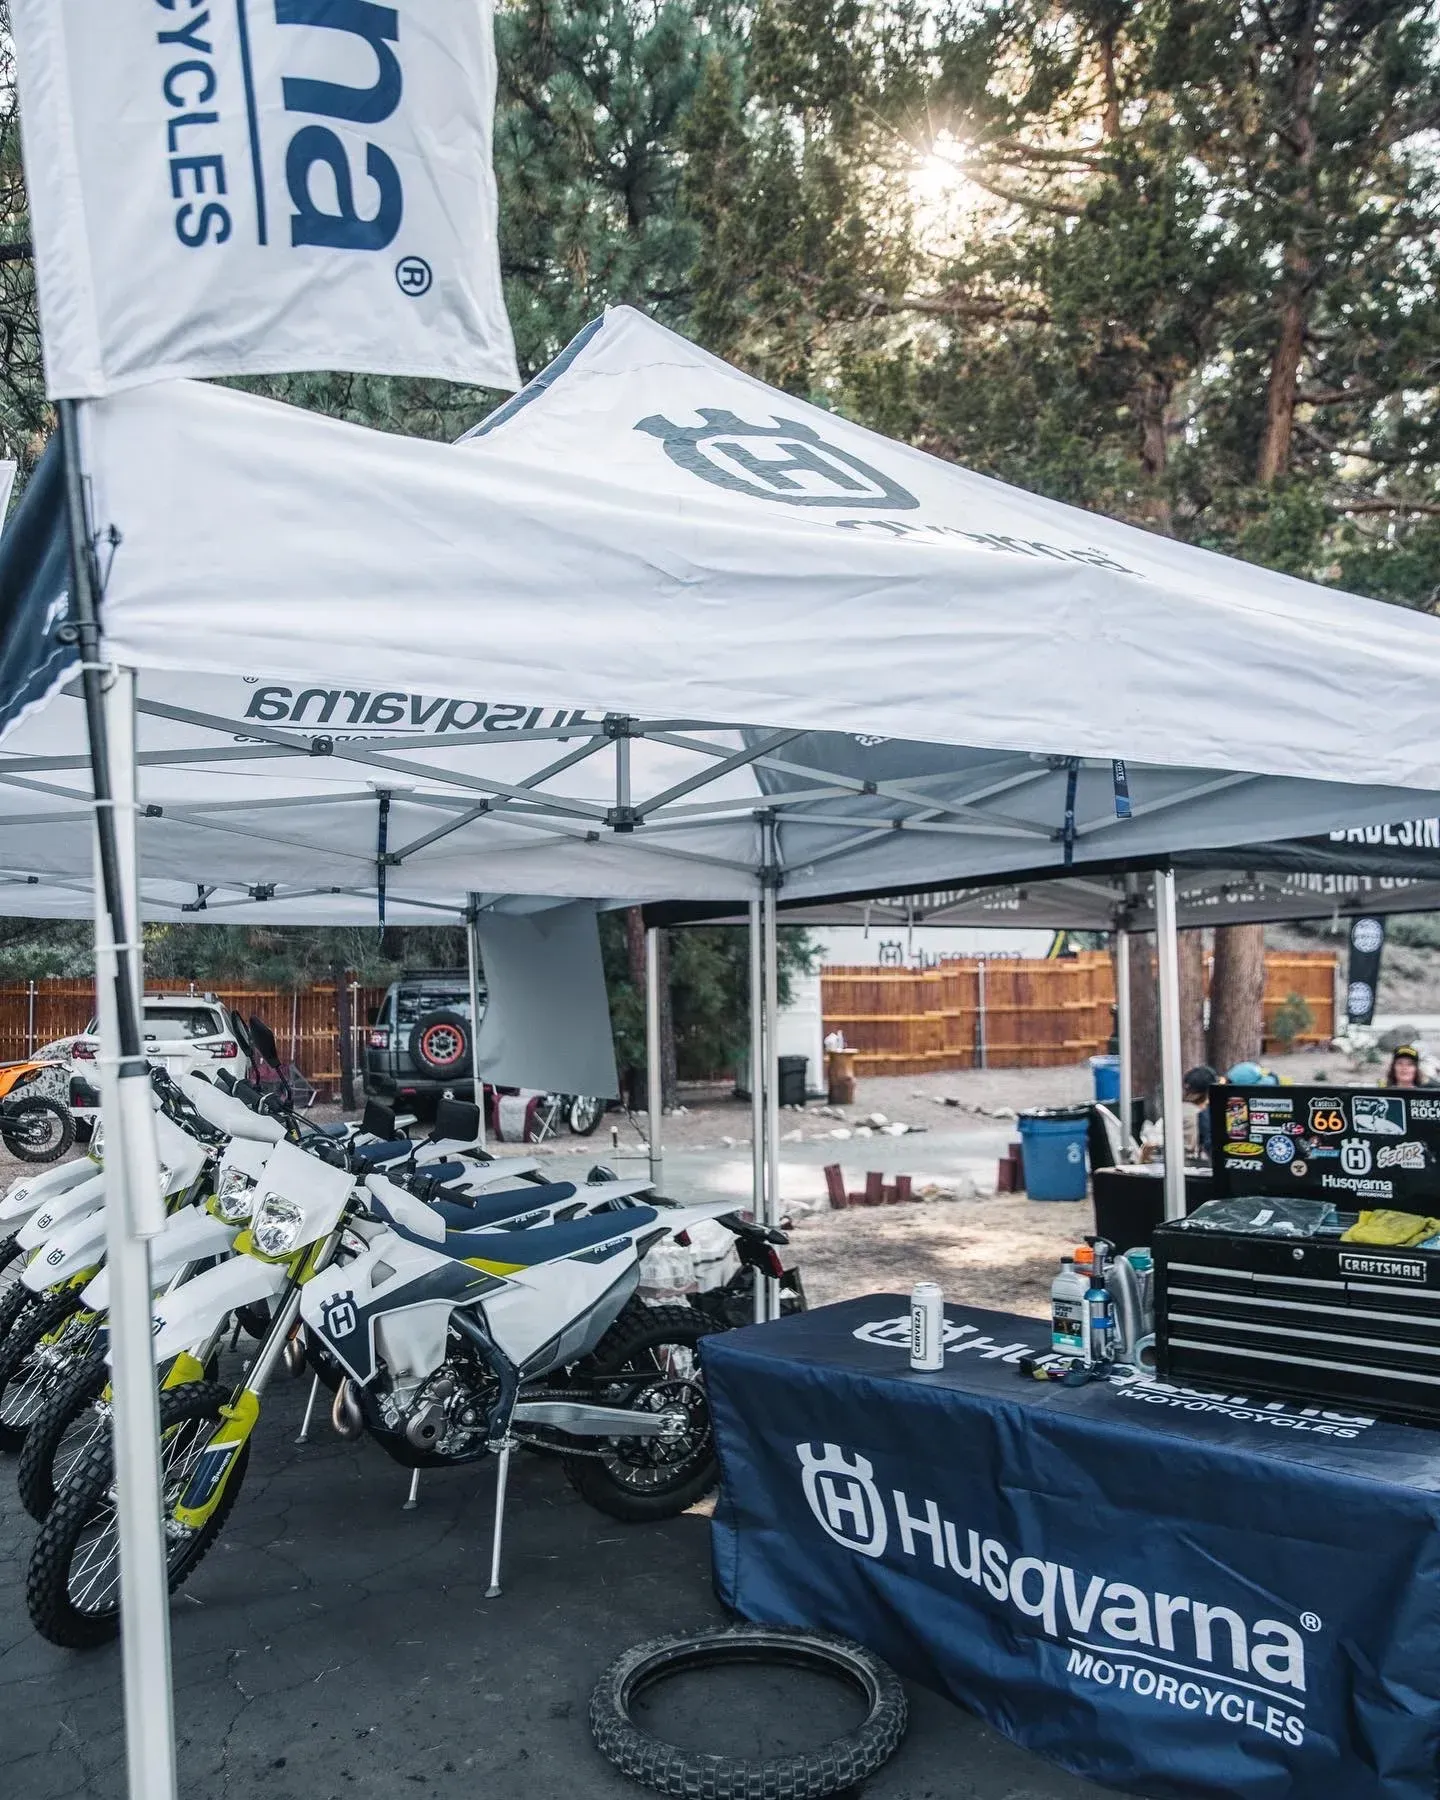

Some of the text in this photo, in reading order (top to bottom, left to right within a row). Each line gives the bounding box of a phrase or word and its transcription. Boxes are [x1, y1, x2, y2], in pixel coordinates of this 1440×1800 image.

[155, 0, 233, 247] YCLES
[1314, 1111, 1343, 1130] 66
[1224, 1158, 1264, 1171] FXR
[1321, 1174, 1393, 1191] Husqvarna
[1344, 1259, 1421, 1277] CRAFTSMAN
[1115, 1388, 1360, 1439] MOTORCYCLES
[892, 1490, 1306, 1692] Husqvarna
[1066, 1648, 1305, 1747] MOTORCYCLES
